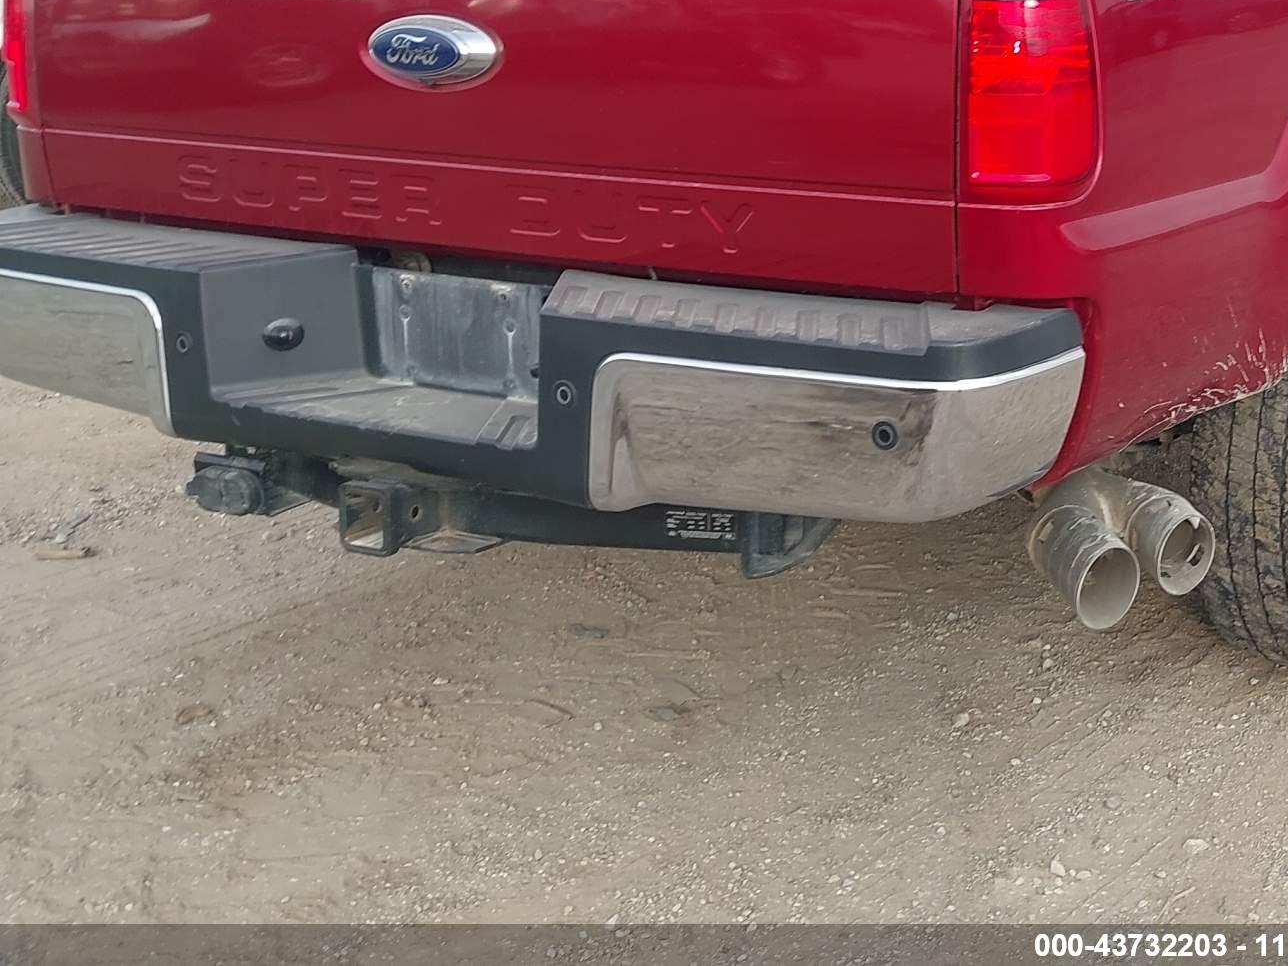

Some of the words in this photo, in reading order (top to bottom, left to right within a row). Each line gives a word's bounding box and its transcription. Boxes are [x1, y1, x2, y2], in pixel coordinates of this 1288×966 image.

[385, 33, 441, 66] Ford
[177, 155, 444, 227] SUPER
[505, 184, 755, 255] DUTY
